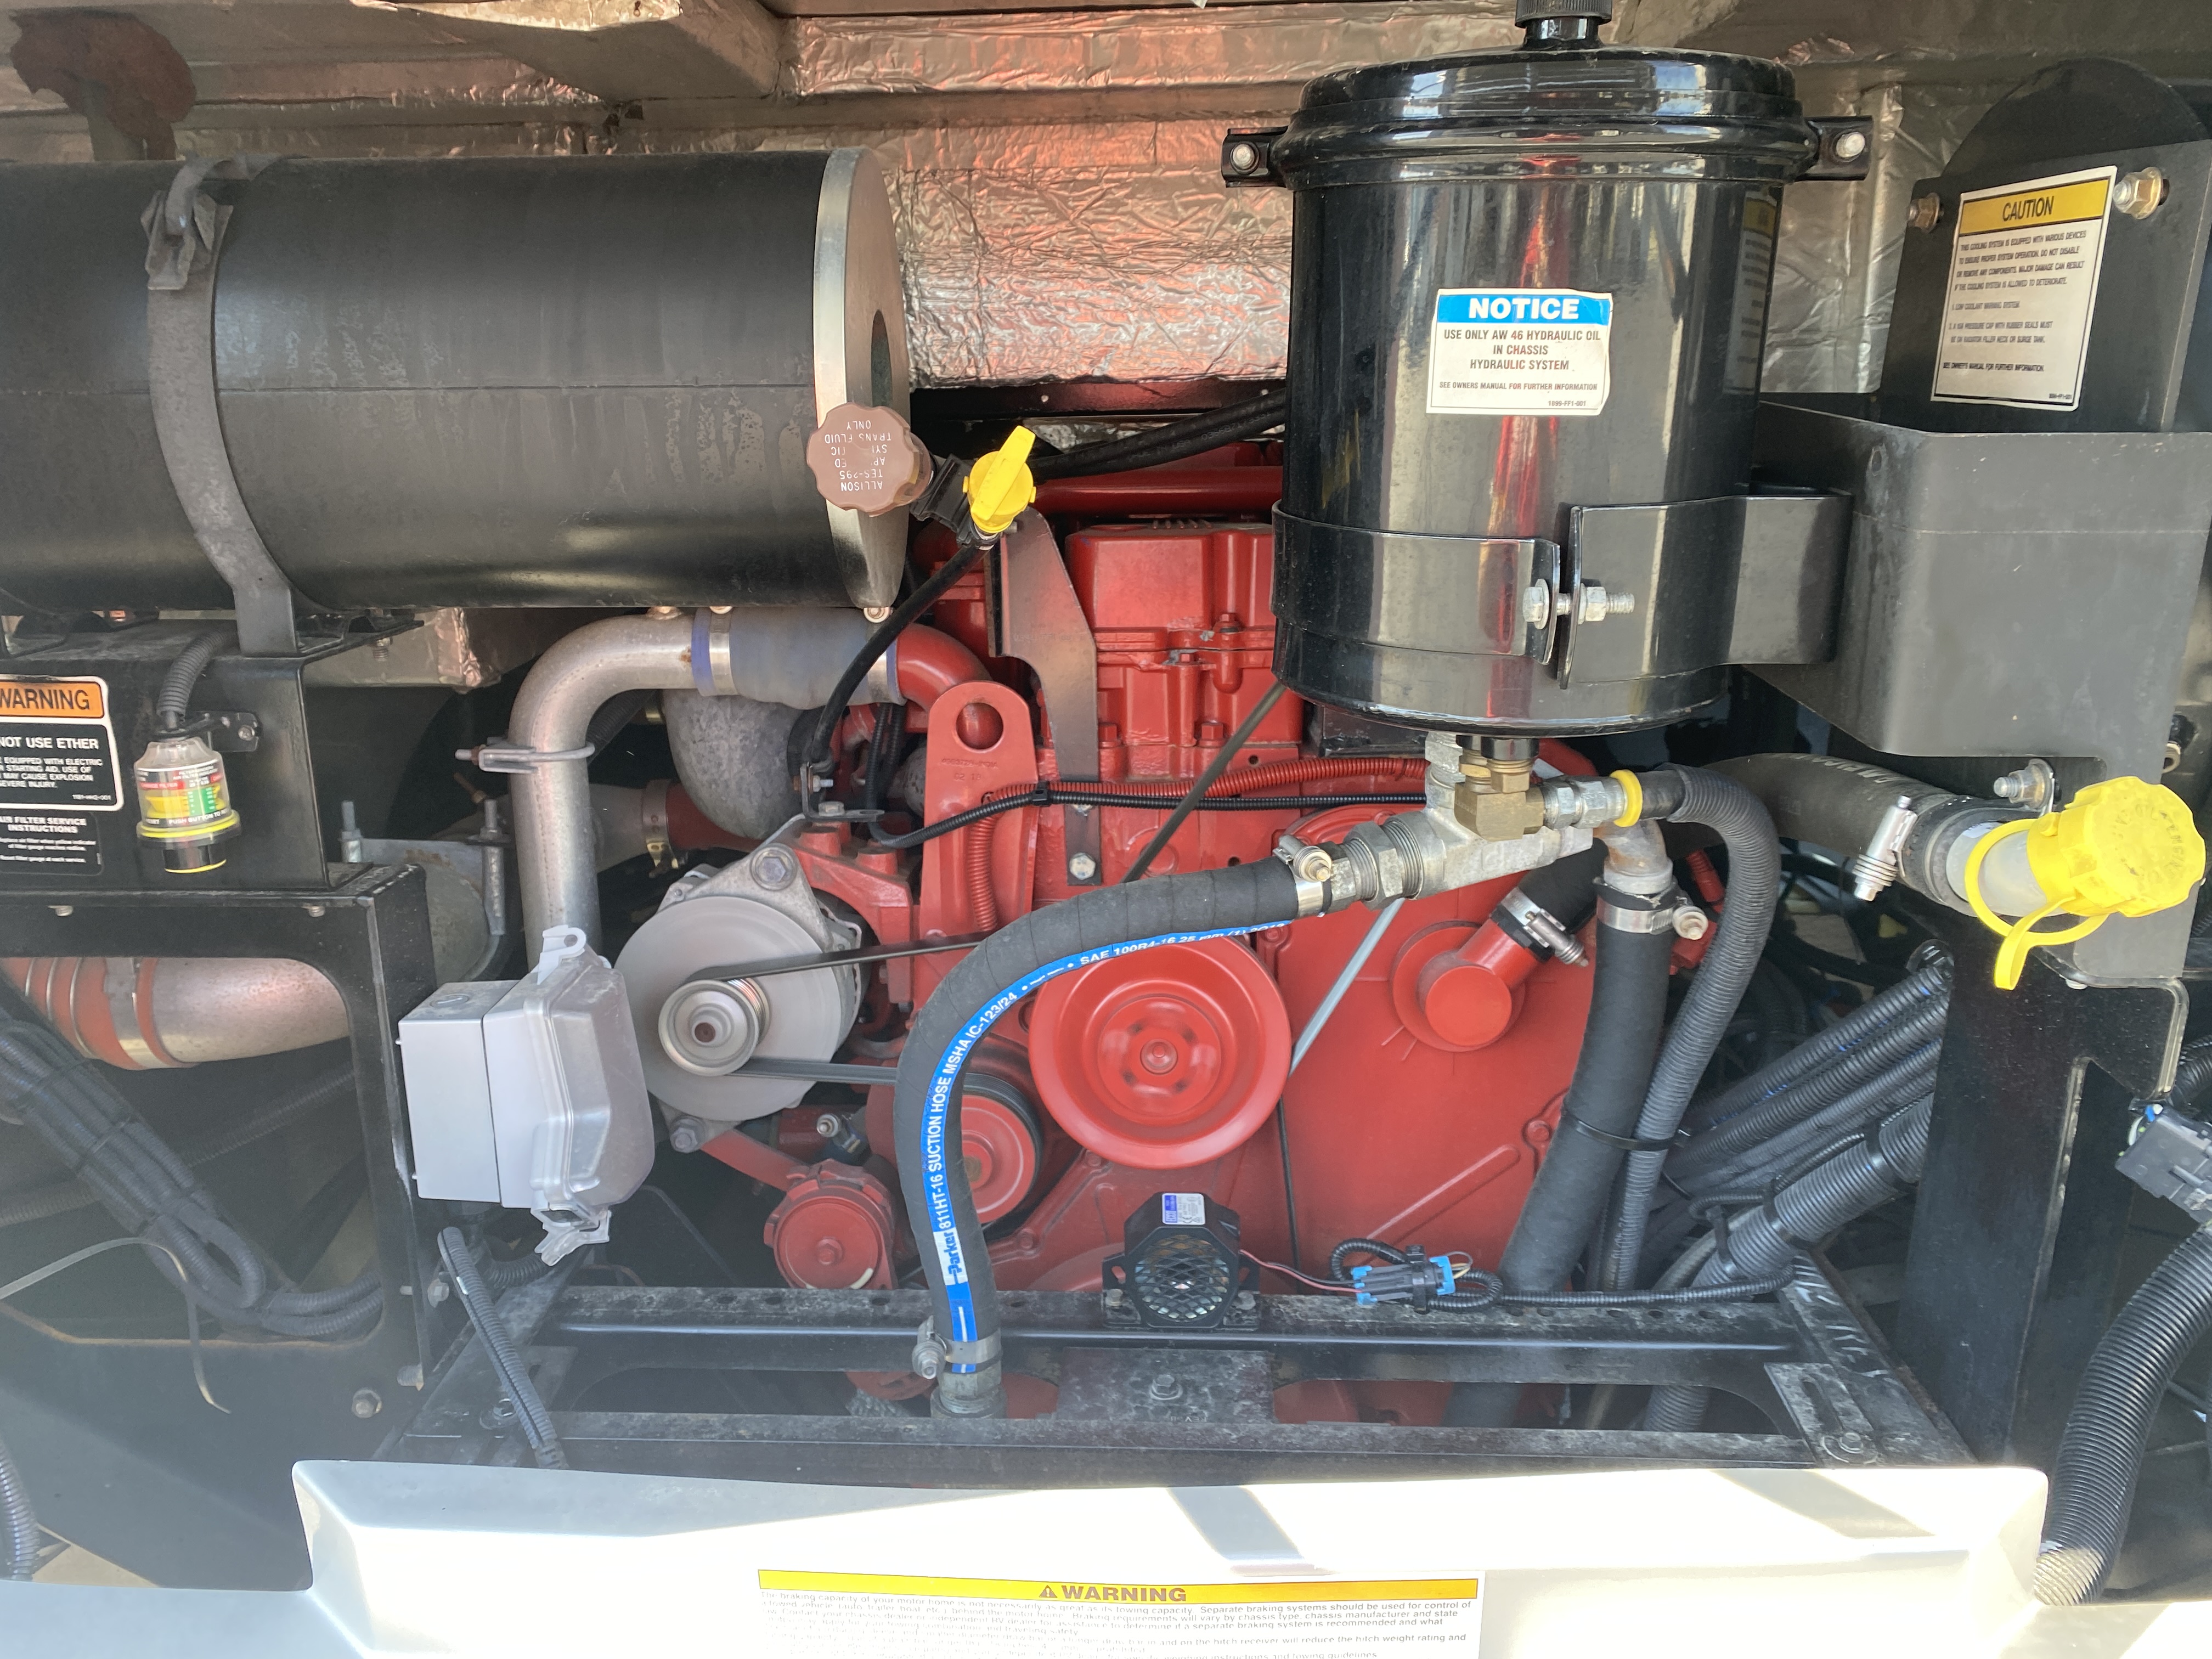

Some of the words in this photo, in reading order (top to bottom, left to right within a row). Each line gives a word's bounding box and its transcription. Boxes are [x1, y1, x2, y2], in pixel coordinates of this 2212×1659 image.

[2003, 196, 2054, 222] CAUTION
[1469, 298, 1579, 319] NOTICE
[1444, 330, 1462, 339] USE
[1465, 330, 1488, 340] ONLY
[1492, 330, 1508, 340] AW
[1511, 330, 1523, 340] 46
[1527, 330, 1583, 340] HYDRAULIC
[1586, 331, 1600, 341] OIL
[1493, 345, 1503, 354] IN
[1506, 345, 1549, 355] CHASSIS
[1470, 359, 1525, 369] HYDRAULIC
[1529, 360, 1568, 370] SYSTEM
[847, 420, 871, 430] ONLY
[824, 434, 853, 443] FLUID
[859, 433, 891, 441] TRANS
[839, 469, 883, 479] TES-295
[841, 481, 883, 492] ALLISON
[0, 689, 89, 710] WARNING
[26, 737, 53, 748] USE
[56, 738, 99, 749] ETHER
[47, 817, 87, 826] SERVICE
[188, 813, 214, 822] BUTTON
[8, 824, 78, 833] INSTRUCTIONS
[1199, 933, 1224, 941] mm
[1113, 936, 1176, 955] 100R4-16
[1080, 950, 1110, 966] SAE
[965, 992, 1018, 1038] IC-123/24
[942, 1039, 973, 1074] MSHA
[931, 1076, 952, 1112] HOSE
[927, 1115, 943, 1172] SUCTION
[930, 1174, 952, 1229] 811HT-16
[944, 1232, 963, 1277] Parker
[1061, 1585, 1187, 1602] WARNING
[780, 1593, 816, 1601] braking
[1200, 1606, 1243, 1614] Separate
[1286, 1605, 1327, 1613] systems
[1224, 1614, 1235, 1622] by
[1383, 1634, 1414, 1643] weight
[1418, 1634, 1445, 1643] rating
